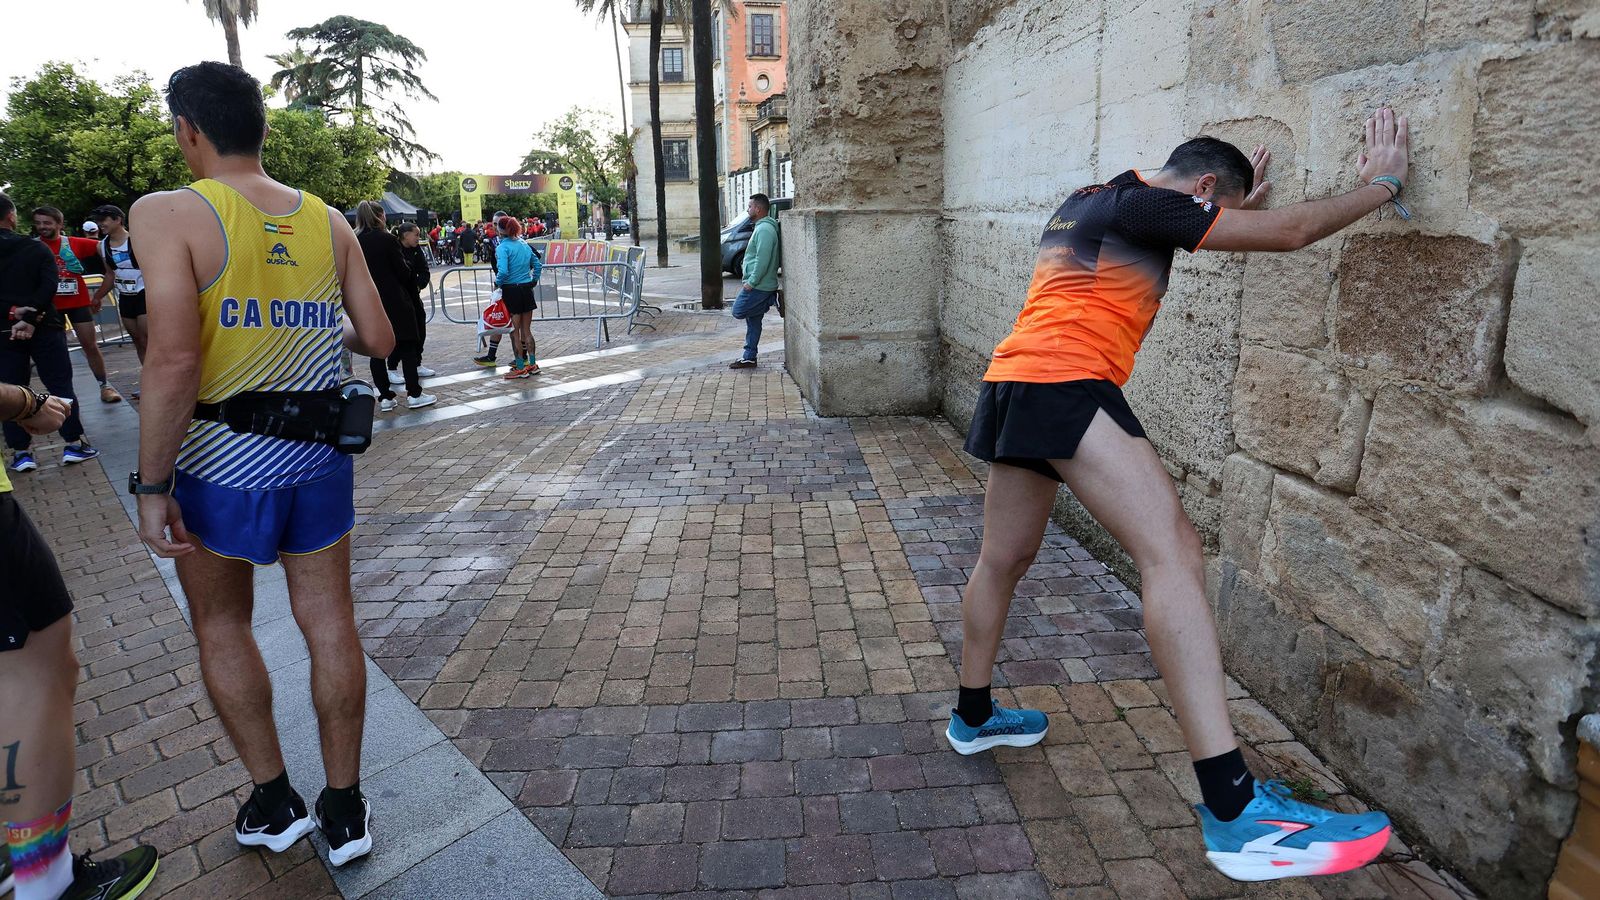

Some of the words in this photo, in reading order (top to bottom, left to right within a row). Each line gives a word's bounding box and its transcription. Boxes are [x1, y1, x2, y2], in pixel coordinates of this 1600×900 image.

[504, 179, 532, 189] Sherry
[269, 299, 337, 329] CORIA
[976, 724, 1025, 738] BROOKS
